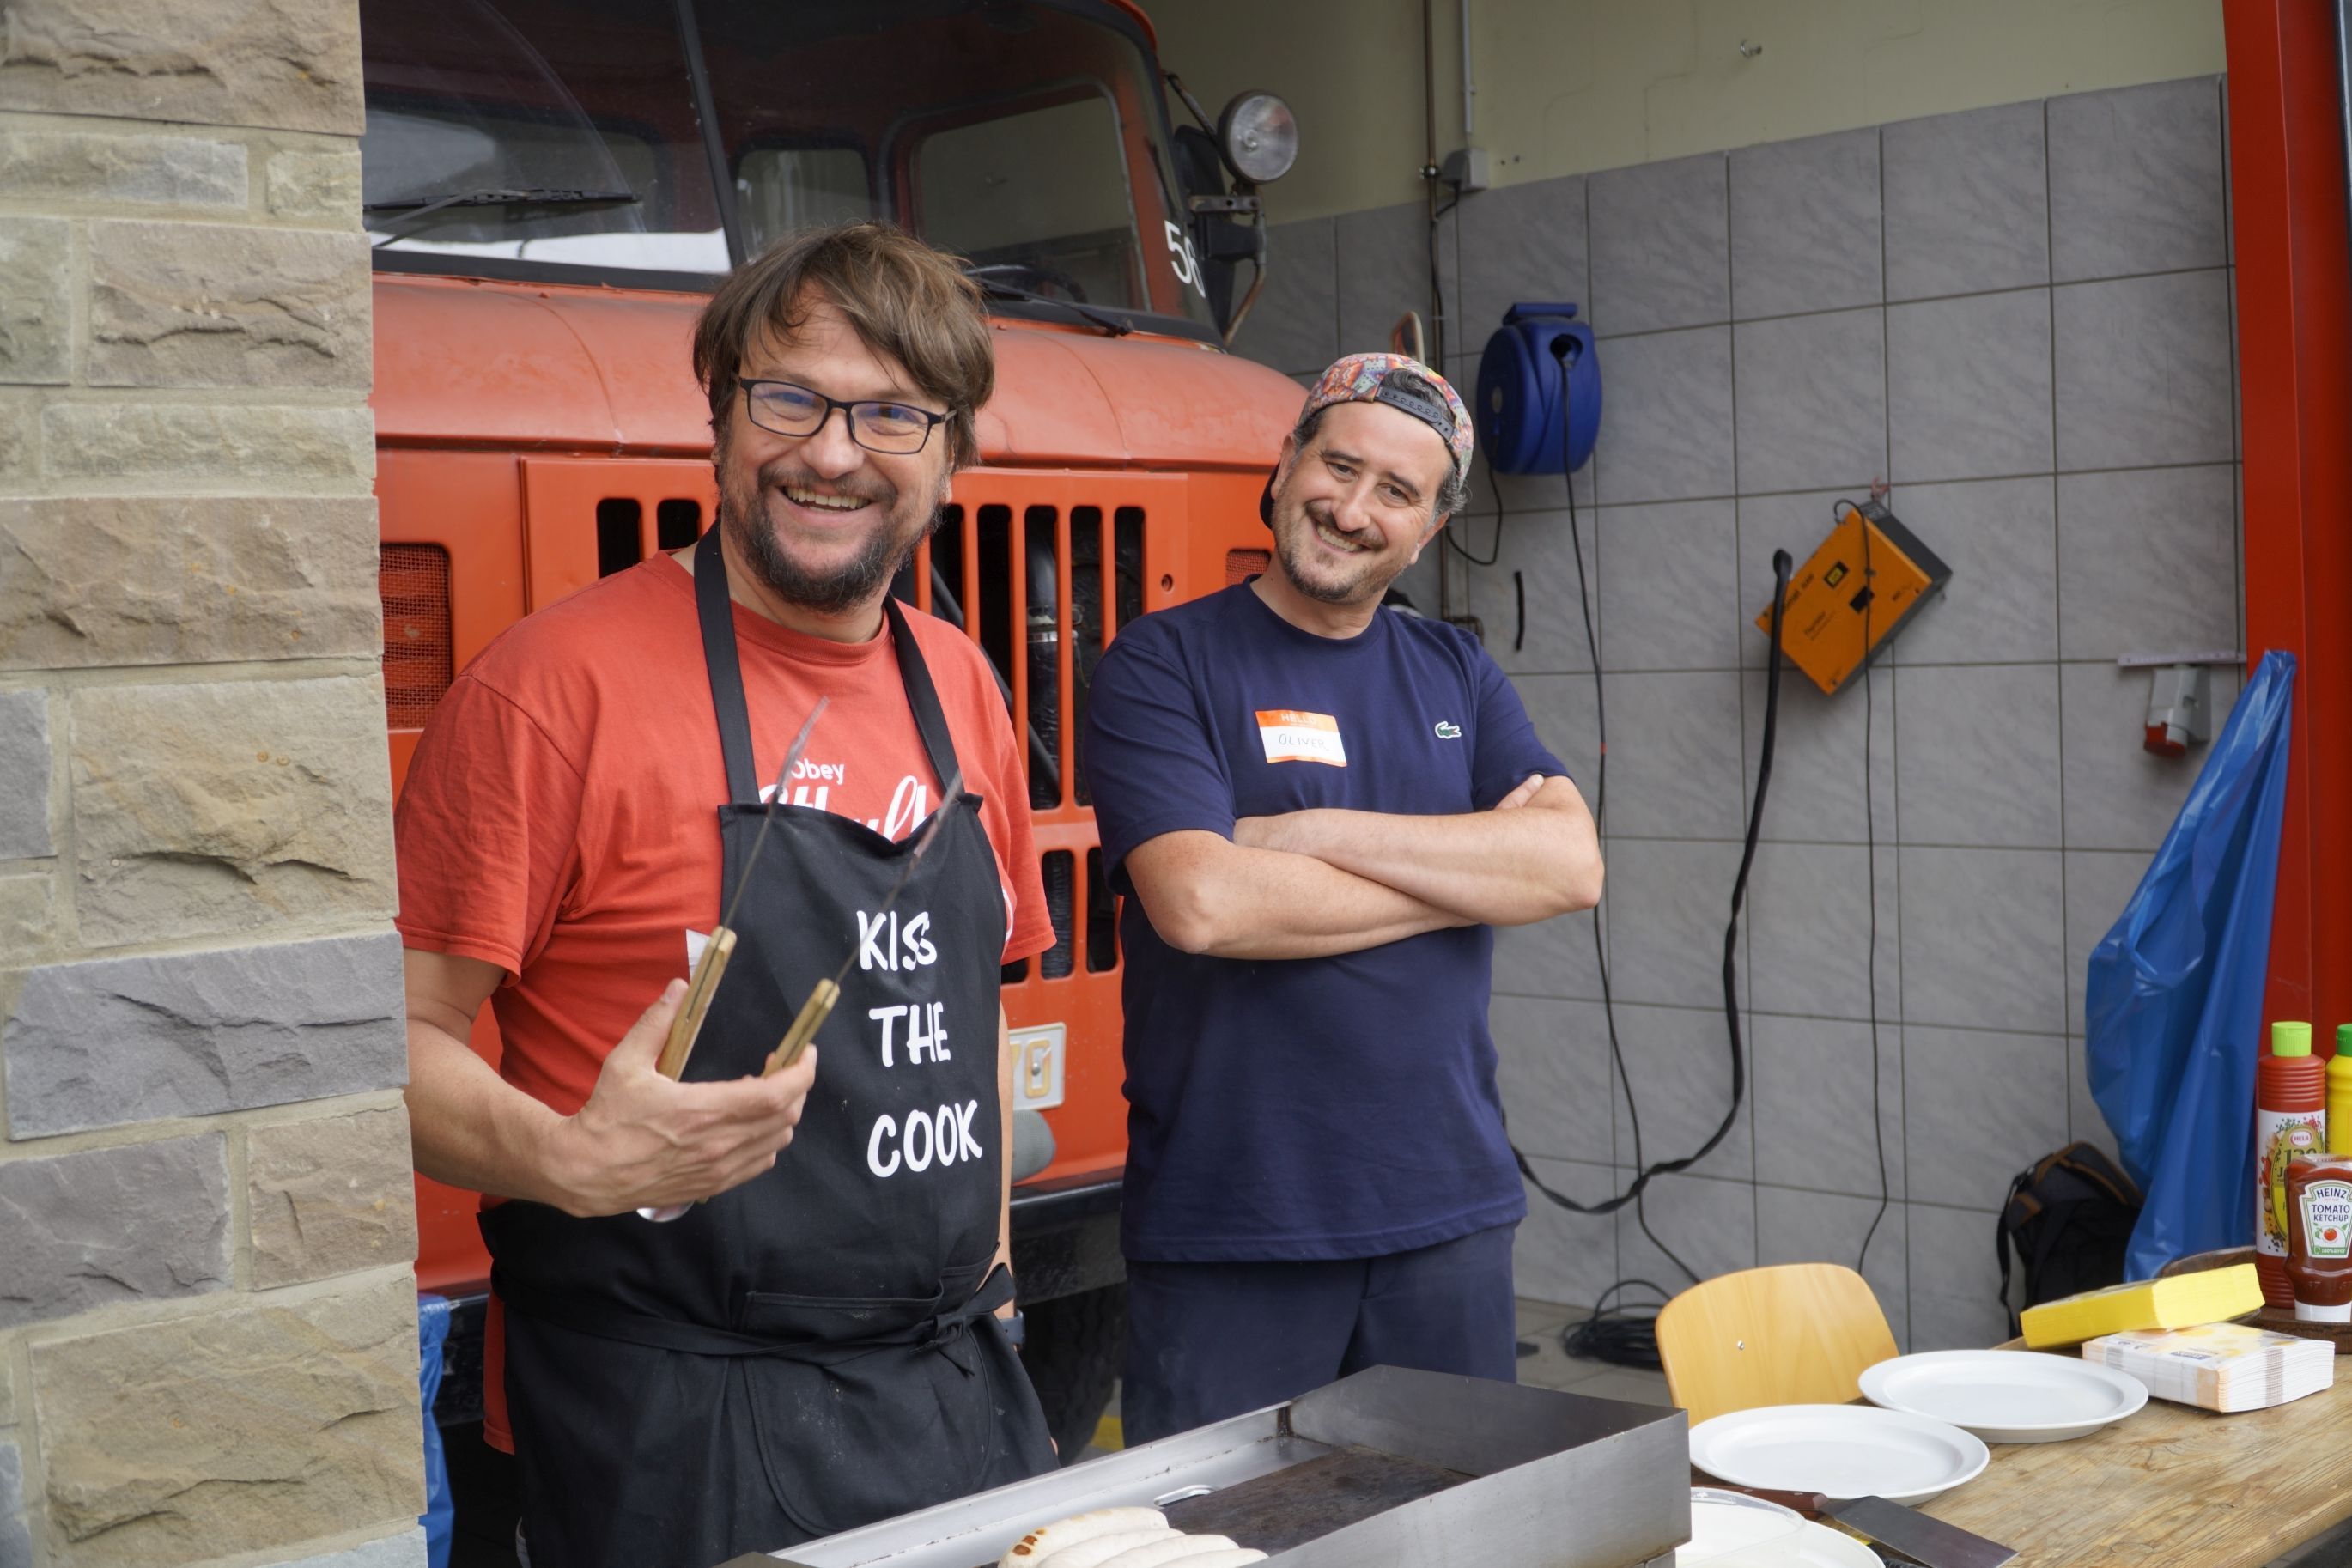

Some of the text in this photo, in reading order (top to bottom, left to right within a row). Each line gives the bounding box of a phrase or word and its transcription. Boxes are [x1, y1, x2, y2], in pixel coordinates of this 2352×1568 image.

[1164, 220, 1206, 298] 56
[1280, 714, 1316, 723] HELLO
[1279, 733, 1327, 750] OLIVER
[856, 910, 937, 971] KISS
[868, 1001, 951, 1067] THE
[866, 1099, 982, 1178] COOK
[2312, 1204, 2350, 1214] TOMATO
[2316, 1188, 2347, 1199] HEINZ
